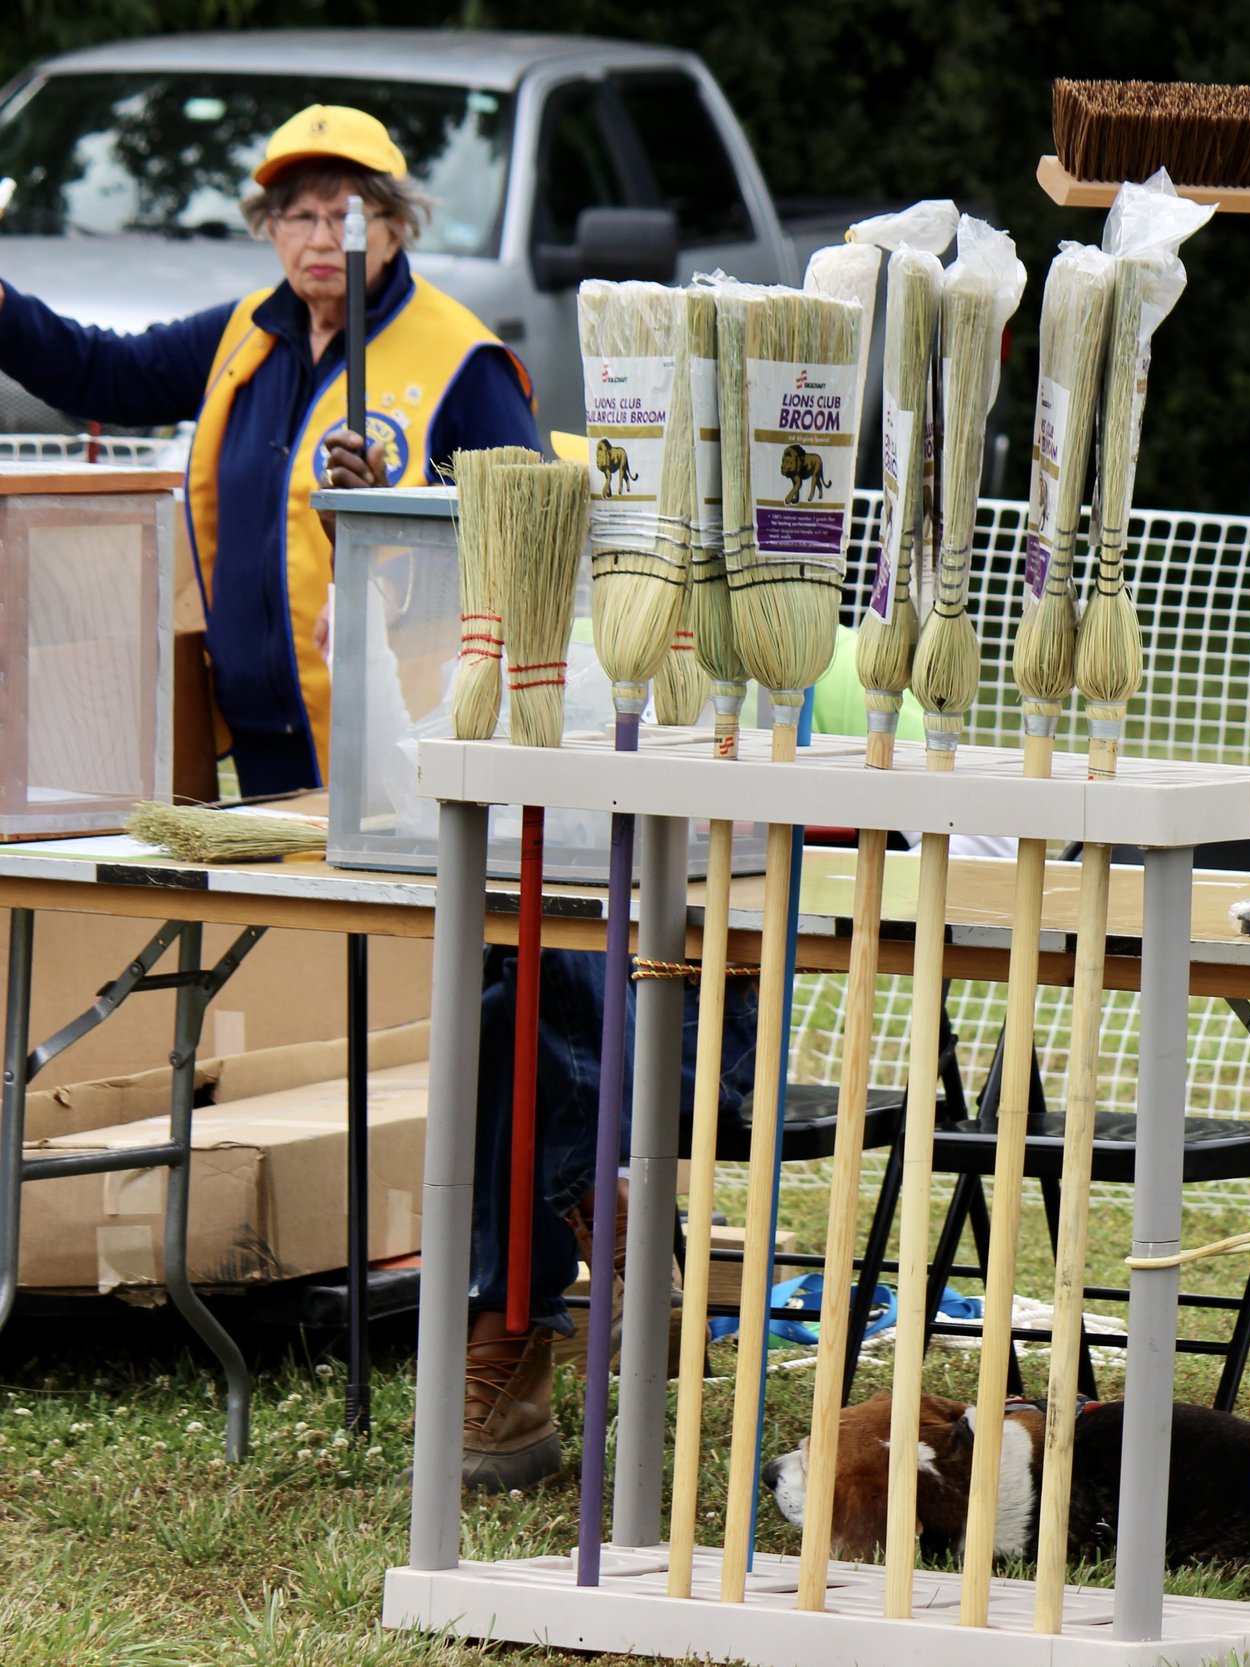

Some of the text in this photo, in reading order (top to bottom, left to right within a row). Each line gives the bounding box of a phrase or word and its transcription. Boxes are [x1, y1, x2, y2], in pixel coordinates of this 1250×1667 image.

[594, 398, 641, 410] LIONS CLUB
[782, 393, 841, 409] LIONS CLUB
[630, 410, 666, 423] BROOM
[779, 408, 840, 431] BROOM
